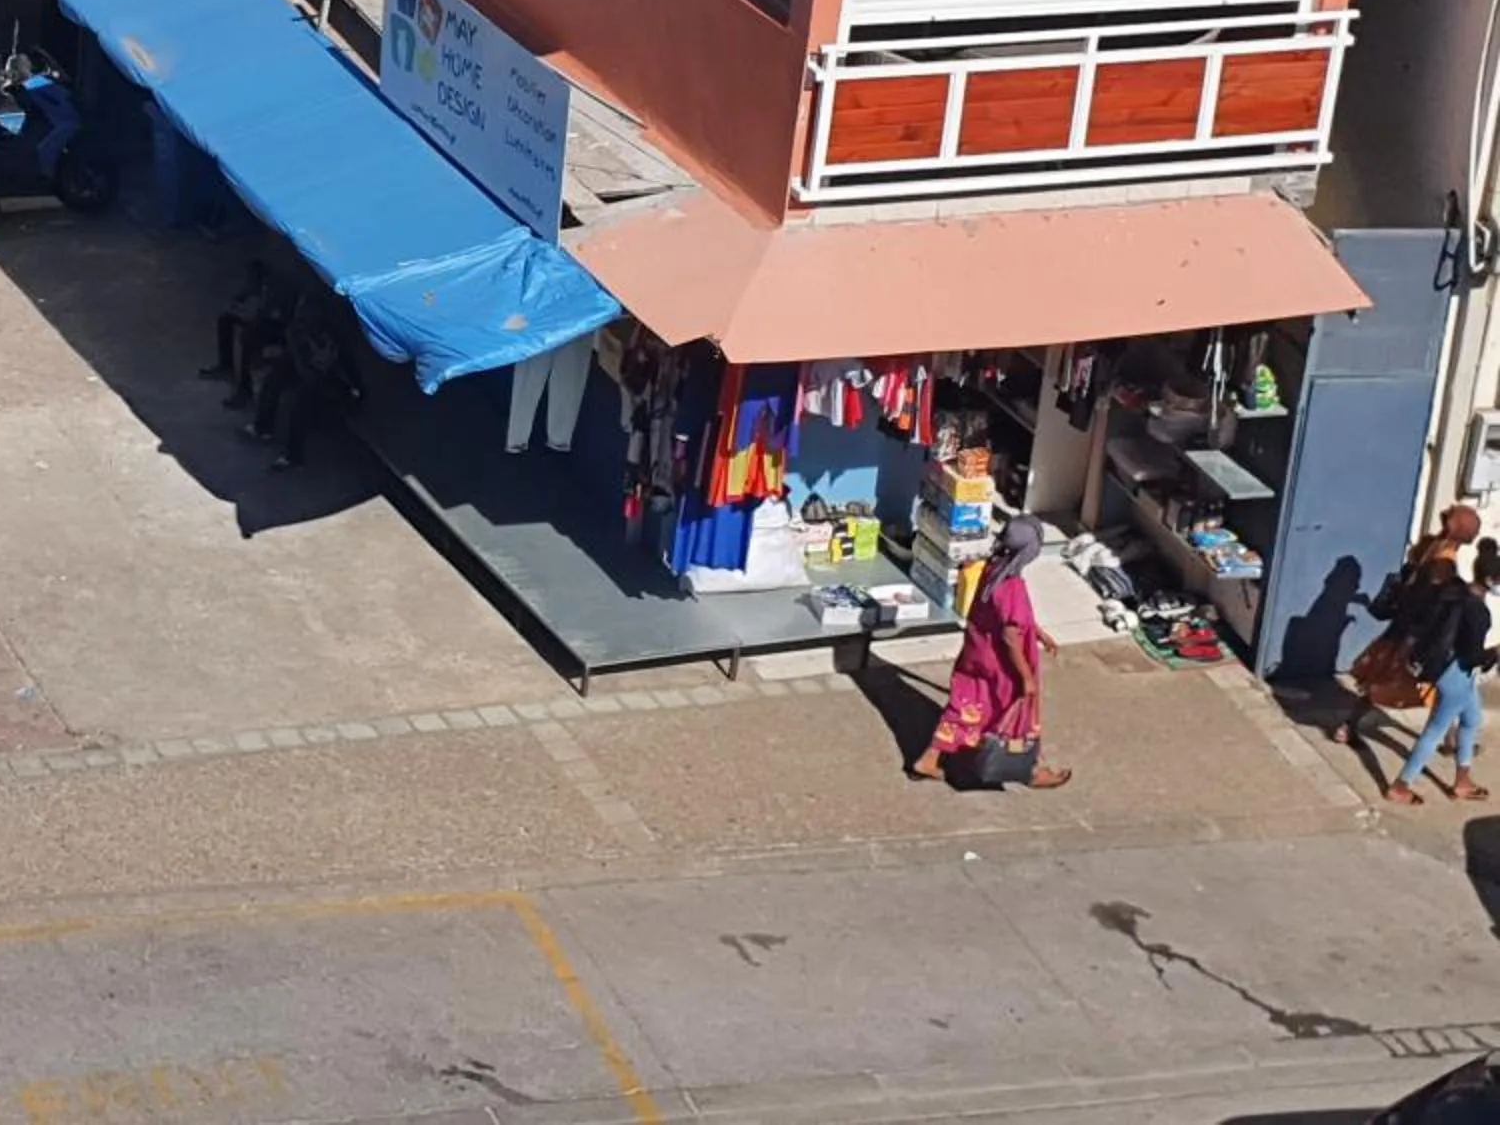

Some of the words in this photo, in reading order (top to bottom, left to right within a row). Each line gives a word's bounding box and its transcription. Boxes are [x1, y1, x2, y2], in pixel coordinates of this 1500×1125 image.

[445, 10, 478, 46] MAY
[441, 43, 484, 90] HOME
[437, 80, 486, 132] DESIGN
